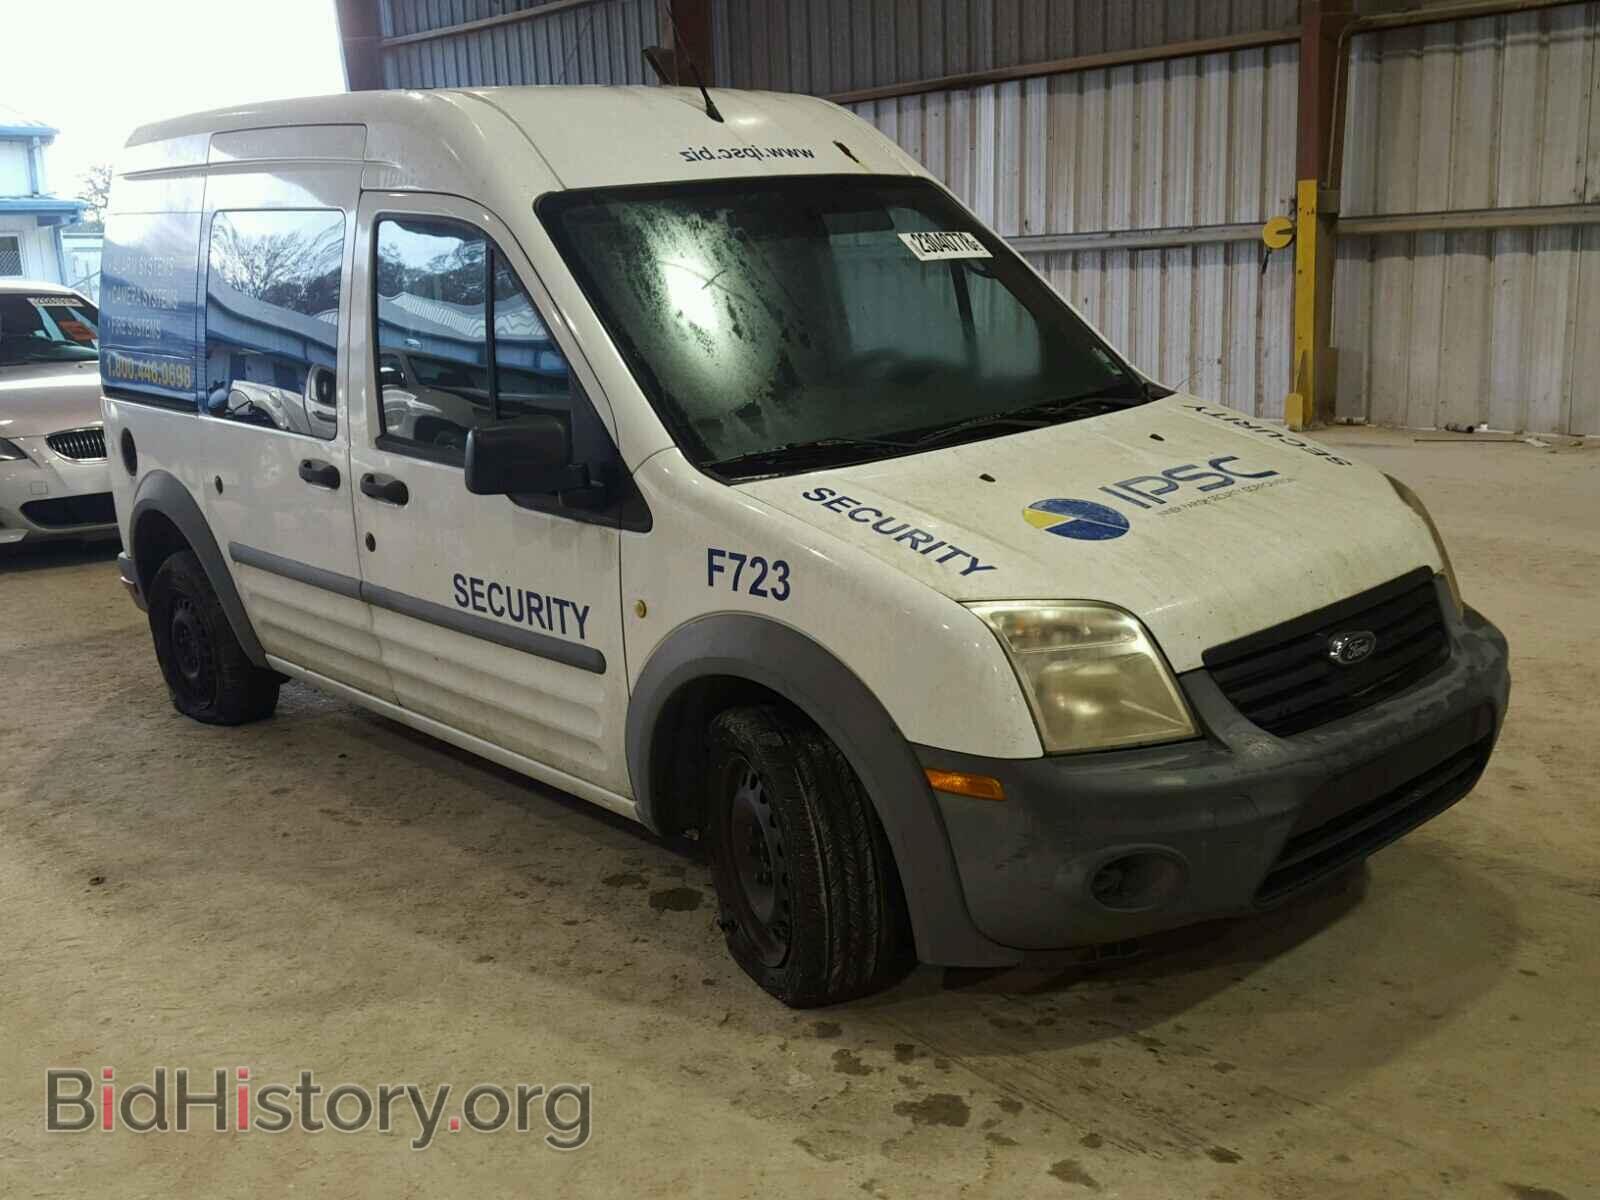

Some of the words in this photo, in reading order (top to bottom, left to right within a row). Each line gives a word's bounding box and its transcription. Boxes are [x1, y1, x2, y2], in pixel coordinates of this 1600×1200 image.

[1183, 405, 1352, 465] SECURITY
[1098, 456, 1280, 509] IPSC
[802, 487, 998, 576] SECURITY
[707, 548, 791, 601] F723
[453, 573, 590, 640] SECURITY
